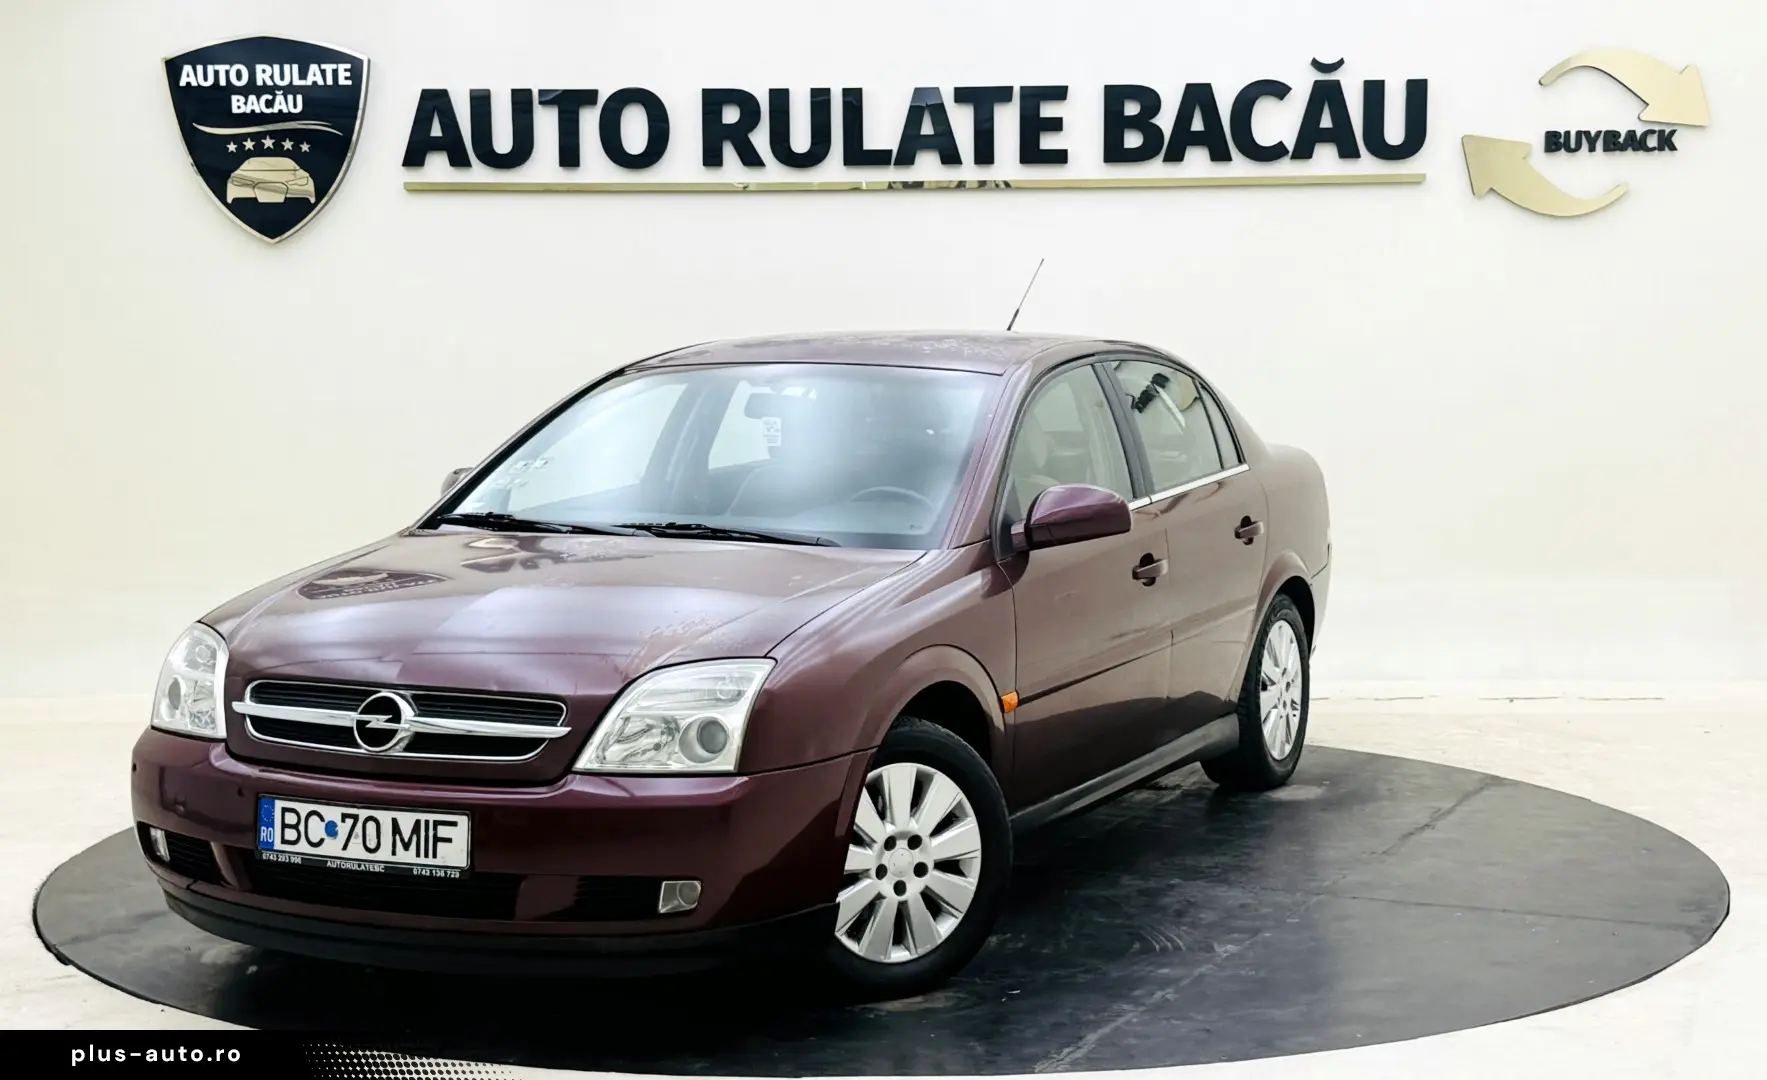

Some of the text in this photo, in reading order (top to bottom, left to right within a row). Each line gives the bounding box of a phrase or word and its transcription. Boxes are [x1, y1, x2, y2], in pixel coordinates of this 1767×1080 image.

[179, 64, 352, 87] AUTO RULATE
[231, 90, 303, 113] BACĂU
[402, 57, 1428, 170] AUTO RULATE BACĂU
[1544, 129, 1678, 153] BUYBACK
[260, 826, 274, 843] RO
[281, 807, 458, 860] BC 70 MIF
